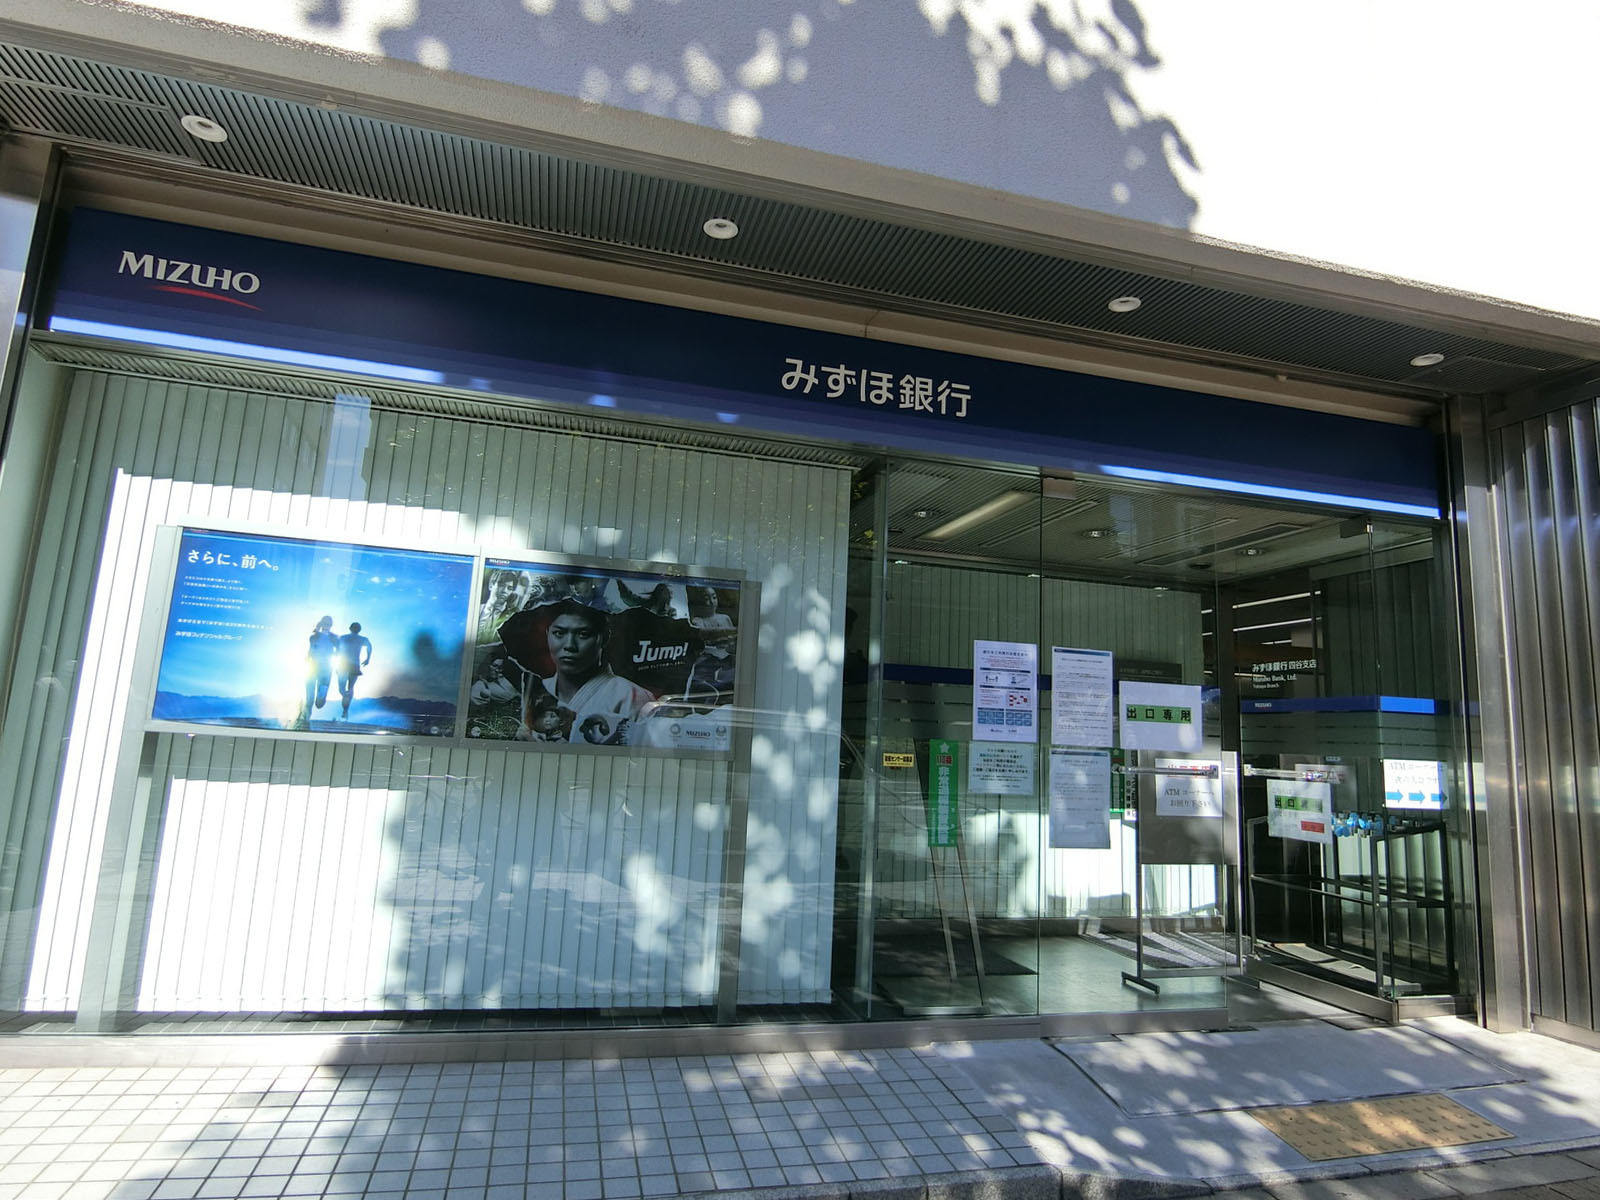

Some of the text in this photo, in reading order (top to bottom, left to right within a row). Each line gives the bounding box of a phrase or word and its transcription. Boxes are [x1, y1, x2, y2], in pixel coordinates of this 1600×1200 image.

[118, 250, 261, 294] MIZUHO
[781, 357, 972, 418] みずほ銀行
[187, 549, 280, 571] さらに、前へ。
[632, 640, 689, 663] Jump!
